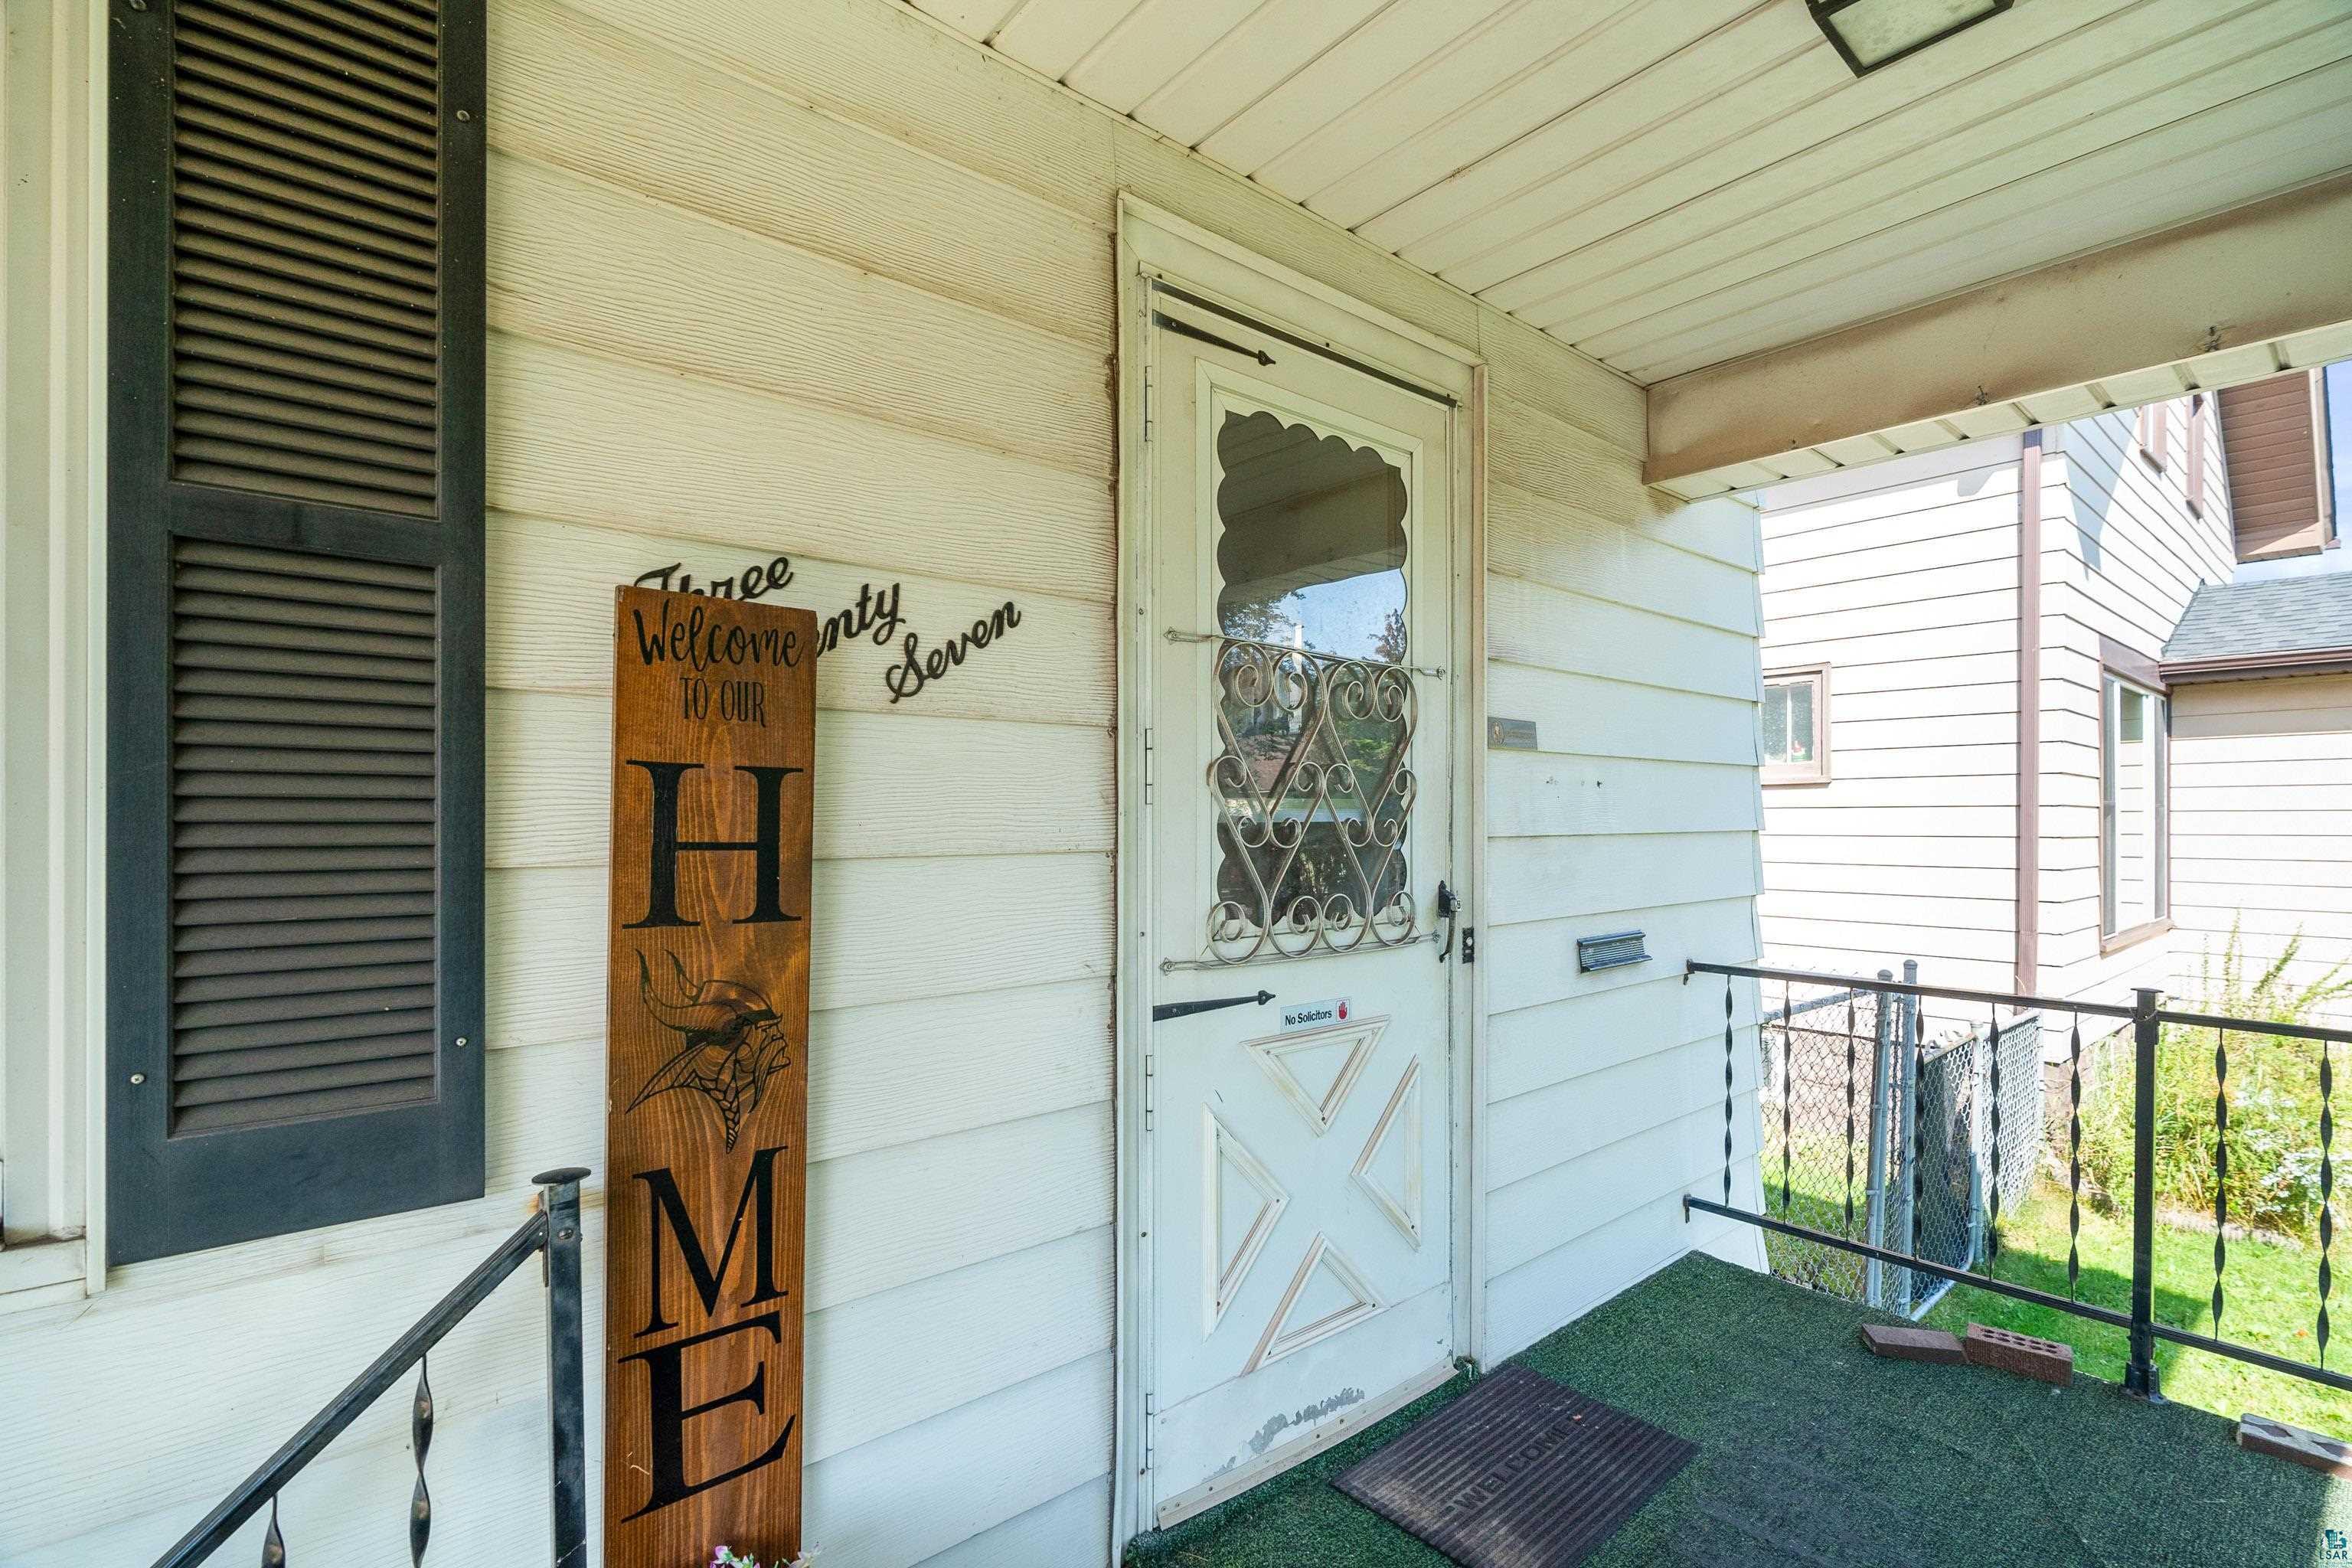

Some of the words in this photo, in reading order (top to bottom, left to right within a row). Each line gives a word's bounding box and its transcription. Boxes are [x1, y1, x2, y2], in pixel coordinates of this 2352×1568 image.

[634, 599, 803, 672] Welcome
[885, 601, 1021, 704] Seven
[680, 678, 708, 720] TO
[720, 680, 766, 728] OUR
[1285, 1015, 1295, 1026] No
[1298, 1010, 1332, 1024] Solicitors
